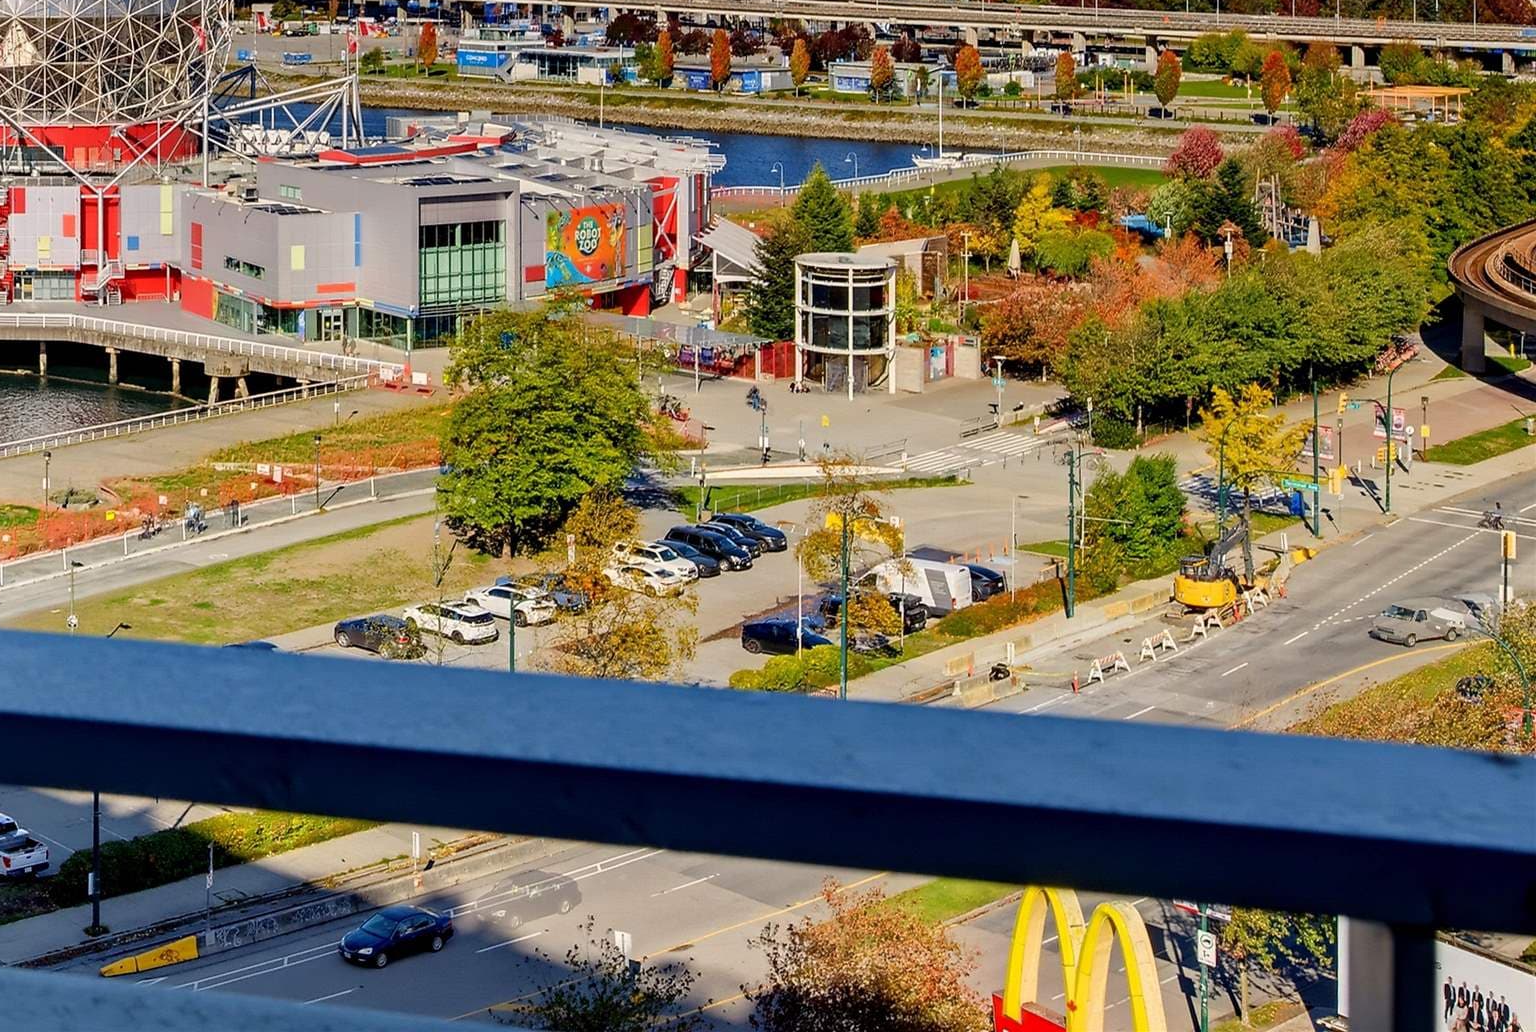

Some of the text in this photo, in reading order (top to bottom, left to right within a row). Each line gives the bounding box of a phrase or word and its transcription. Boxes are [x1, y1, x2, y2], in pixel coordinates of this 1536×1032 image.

[584, 220, 594, 229] THE
[575, 227, 601, 240] ROBOT
[579, 239, 597, 250] ZOO
